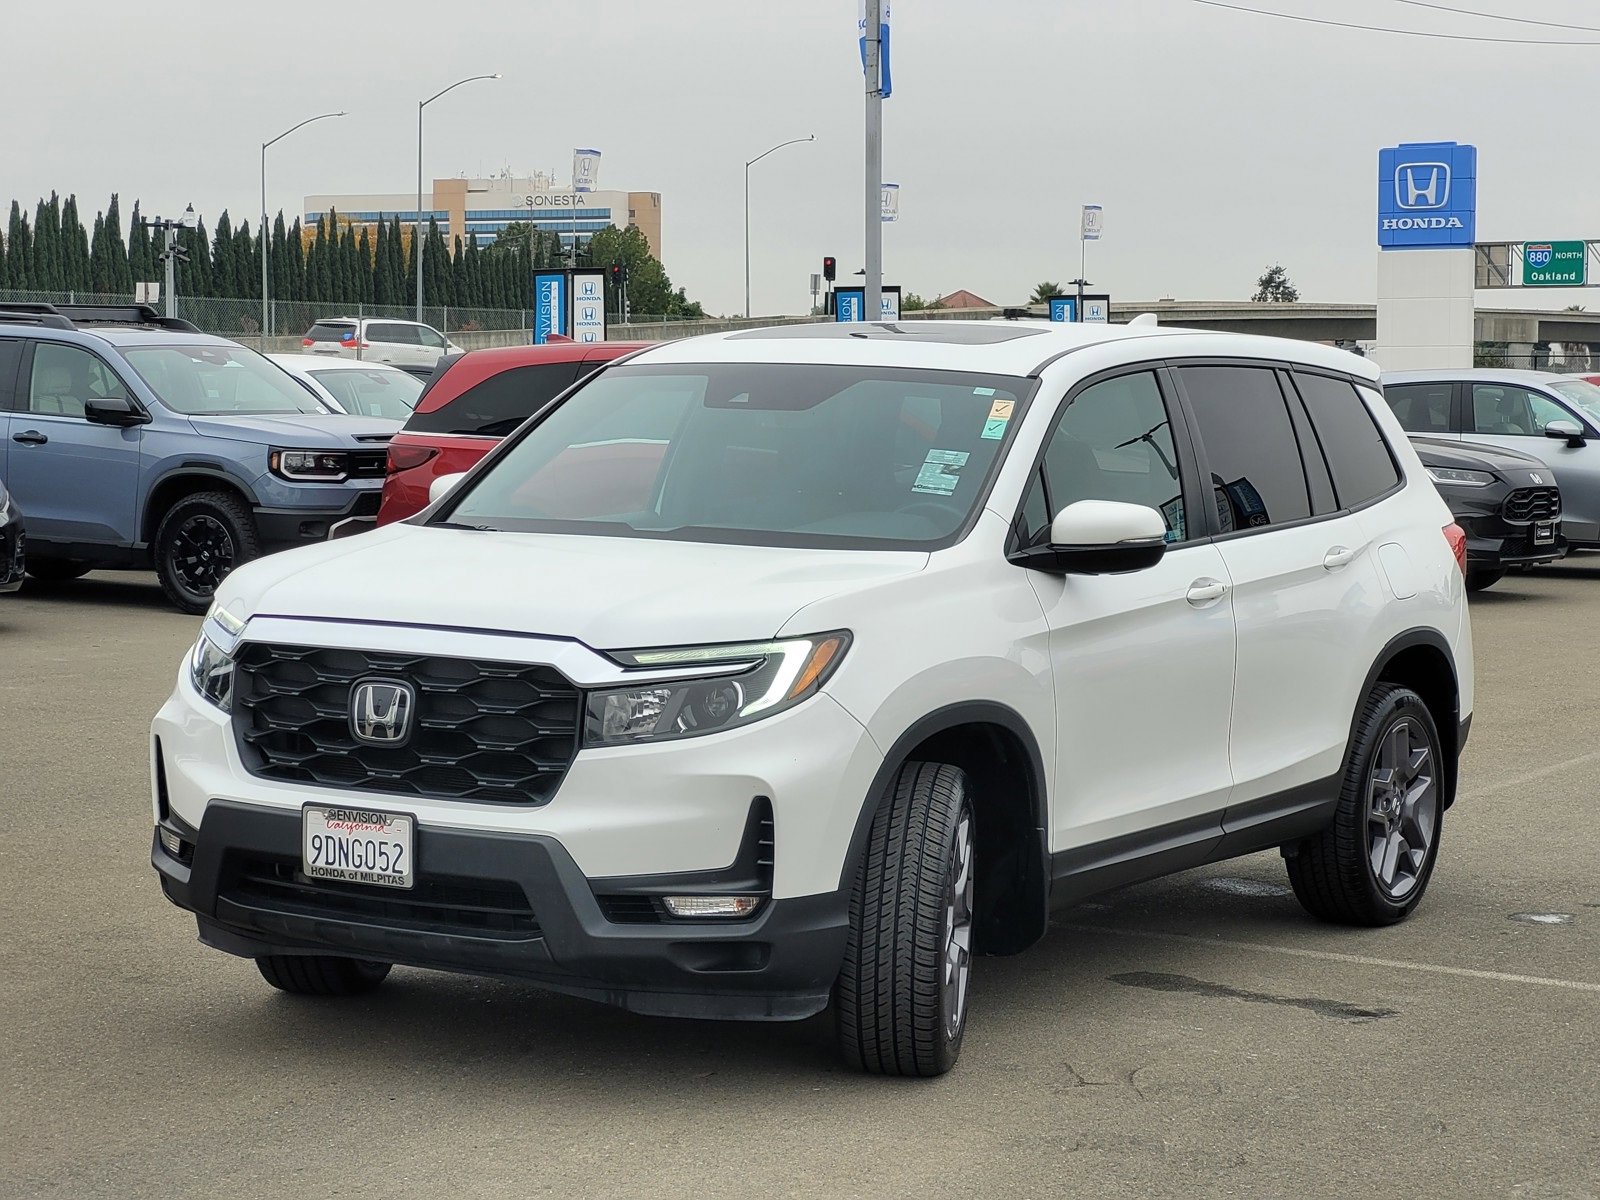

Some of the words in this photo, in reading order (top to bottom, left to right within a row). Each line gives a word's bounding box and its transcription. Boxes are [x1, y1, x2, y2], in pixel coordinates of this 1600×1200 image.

[525, 195, 585, 206] SONESTA
[1382, 217, 1464, 230] HONDA
[1529, 251, 1550, 262] 880
[1531, 272, 1576, 281] Oakland
[337, 810, 387, 824] ENVISION
[326, 820, 391, 835] California
[311, 834, 404, 875] 9DNG052
[311, 866, 346, 879] HONDA
[348, 872, 358, 881] of
[360, 872, 405, 886] MILPITAS
